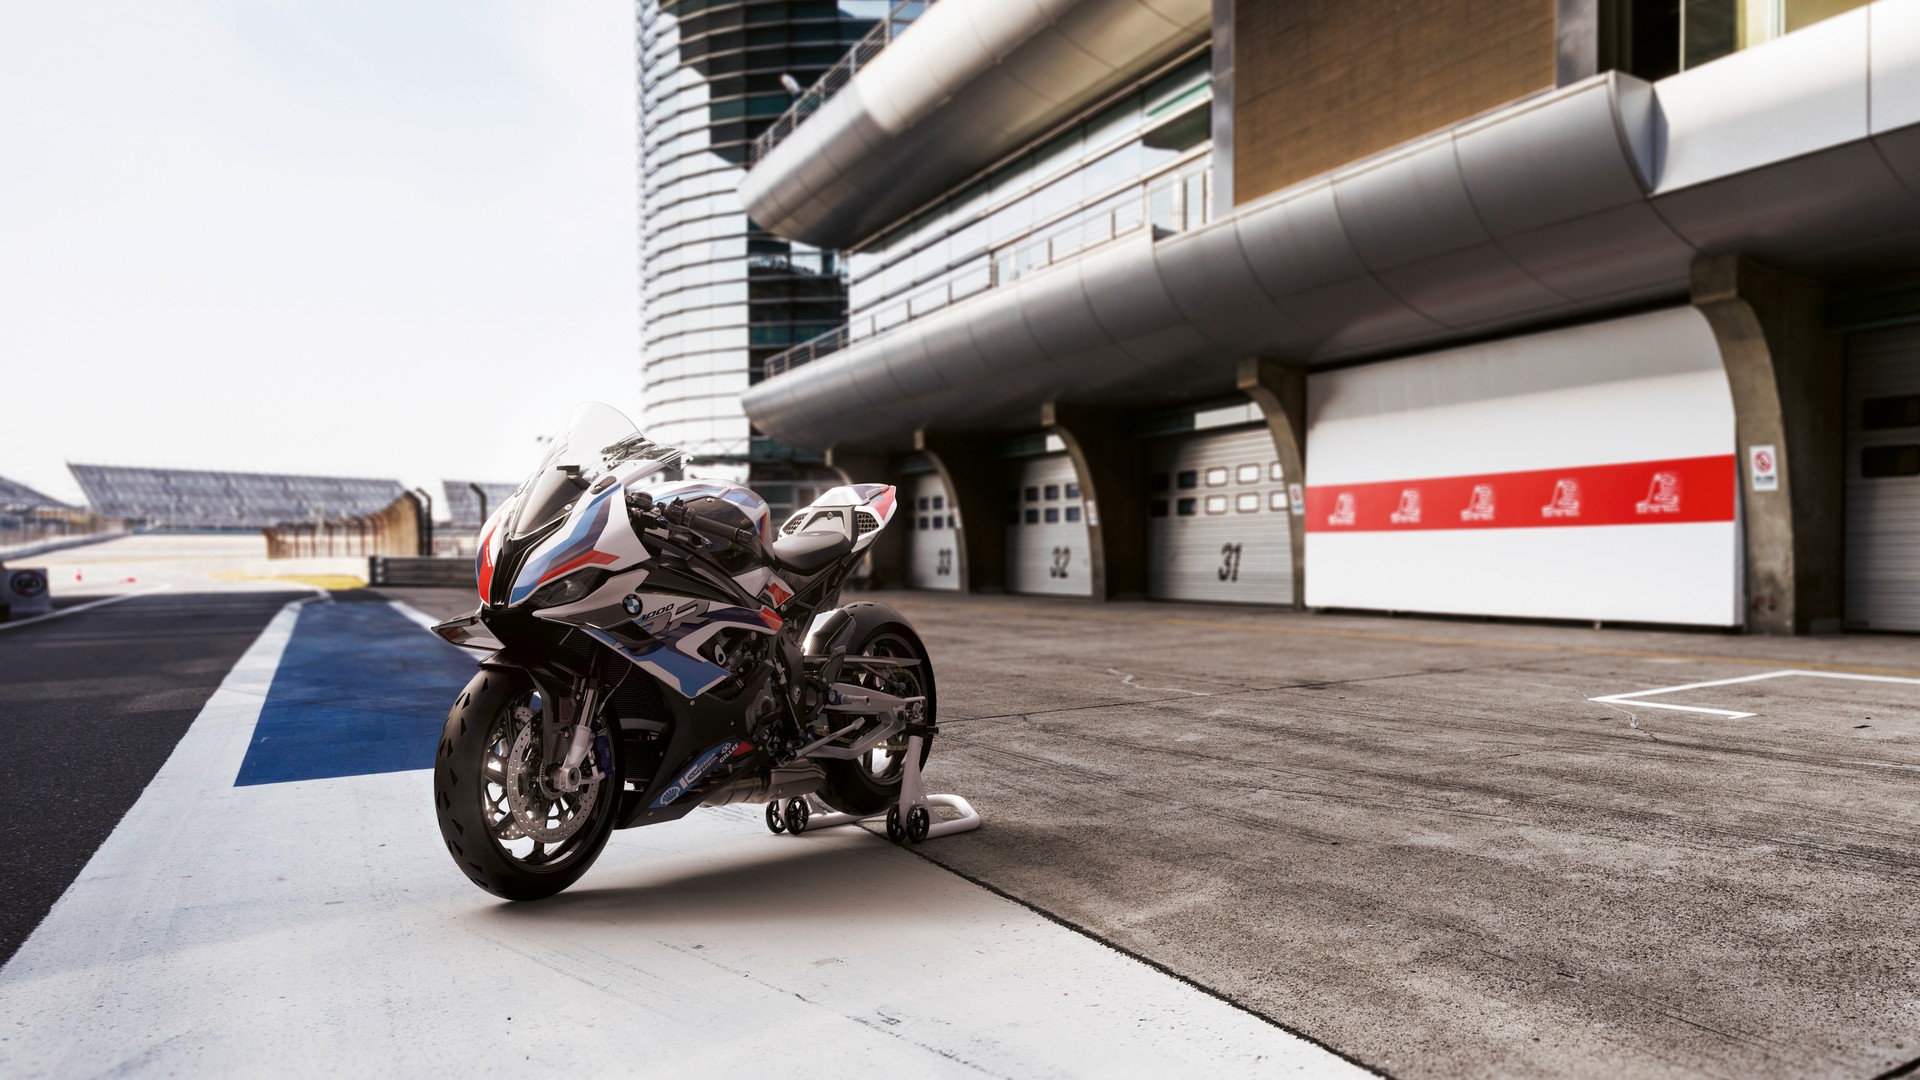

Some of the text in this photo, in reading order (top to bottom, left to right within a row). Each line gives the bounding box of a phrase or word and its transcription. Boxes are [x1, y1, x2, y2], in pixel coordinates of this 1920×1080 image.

[936, 548, 952, 576] 33
[1050, 545, 1071, 579] 32
[1218, 542, 1242, 582] 31
[641, 603, 674, 620] 1000
[719, 743, 739, 763] GILLES
